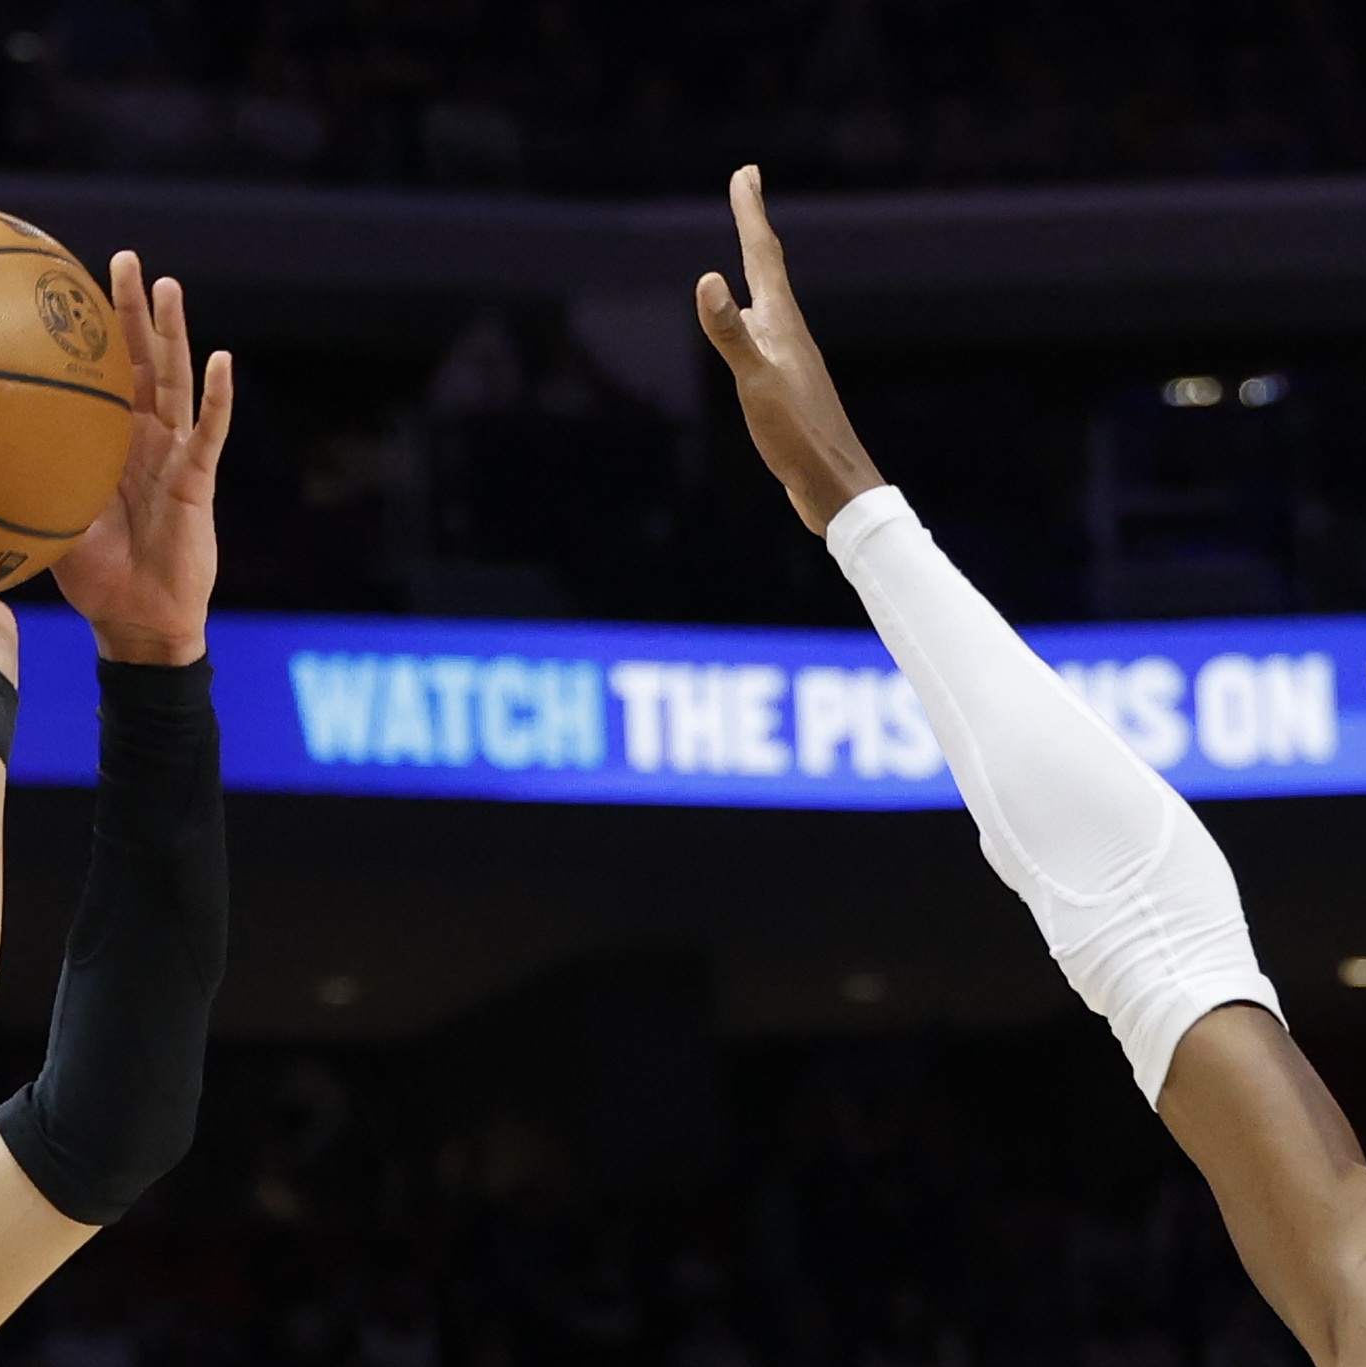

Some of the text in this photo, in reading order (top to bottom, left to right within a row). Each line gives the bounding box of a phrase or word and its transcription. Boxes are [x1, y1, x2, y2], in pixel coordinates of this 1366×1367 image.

[289, 652, 607, 770] WATCH
[609, 660, 794, 778] THE
[1194, 652, 1337, 768] ON
